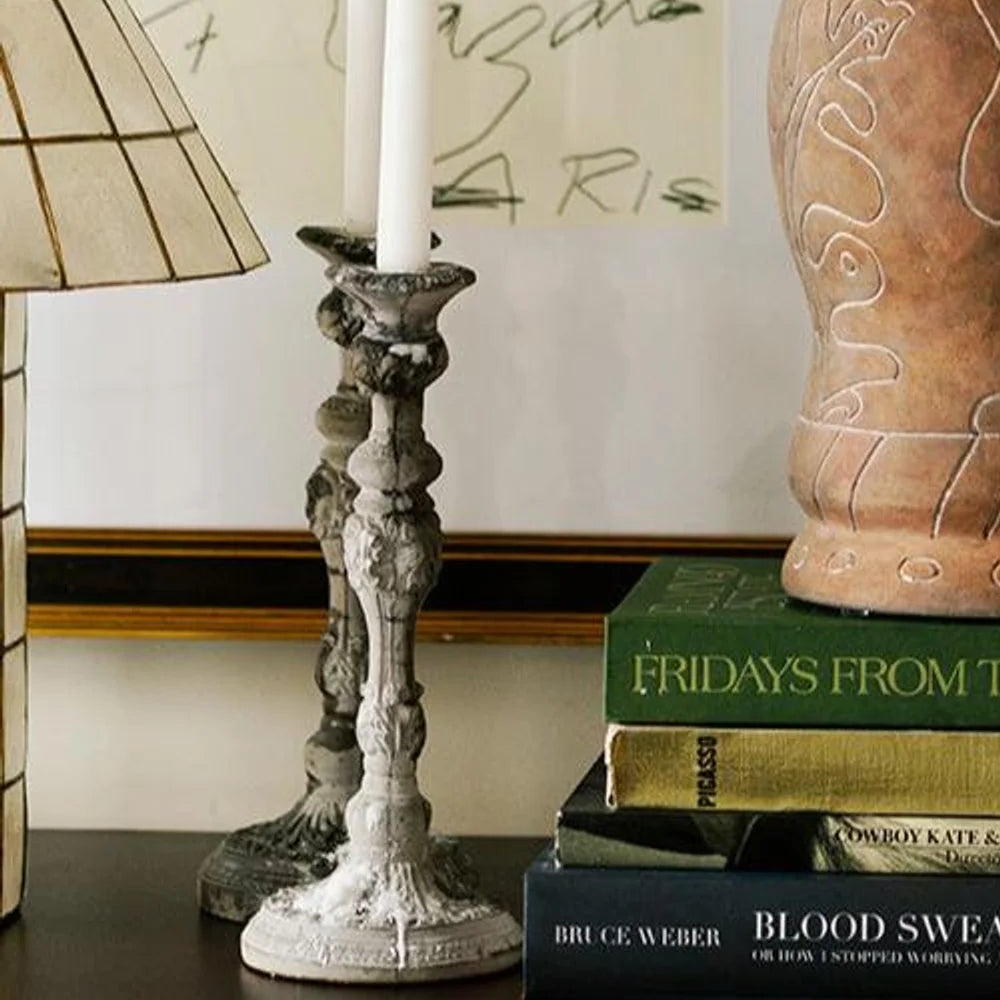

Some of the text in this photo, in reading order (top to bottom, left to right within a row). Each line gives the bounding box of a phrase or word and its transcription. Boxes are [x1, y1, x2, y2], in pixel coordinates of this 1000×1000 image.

[632, 653, 818, 697] FRIDAYS
[831, 656, 967, 697] FROM
[697, 736, 717, 807] PICASSO
[834, 828, 921, 845] COWBOY
[926, 829, 980, 845] KATE
[984, 831, 1000, 846] &
[555, 925, 721, 948] BRUCE WEBER
[754, 911, 887, 942] BLOOD
[751, 949, 774, 962] OR
[778, 949, 814, 963] HOW
[820, 950, 827, 963] I
[831, 950, 903, 964] STOPPED
[907, 951, 993, 966] WORRYING
